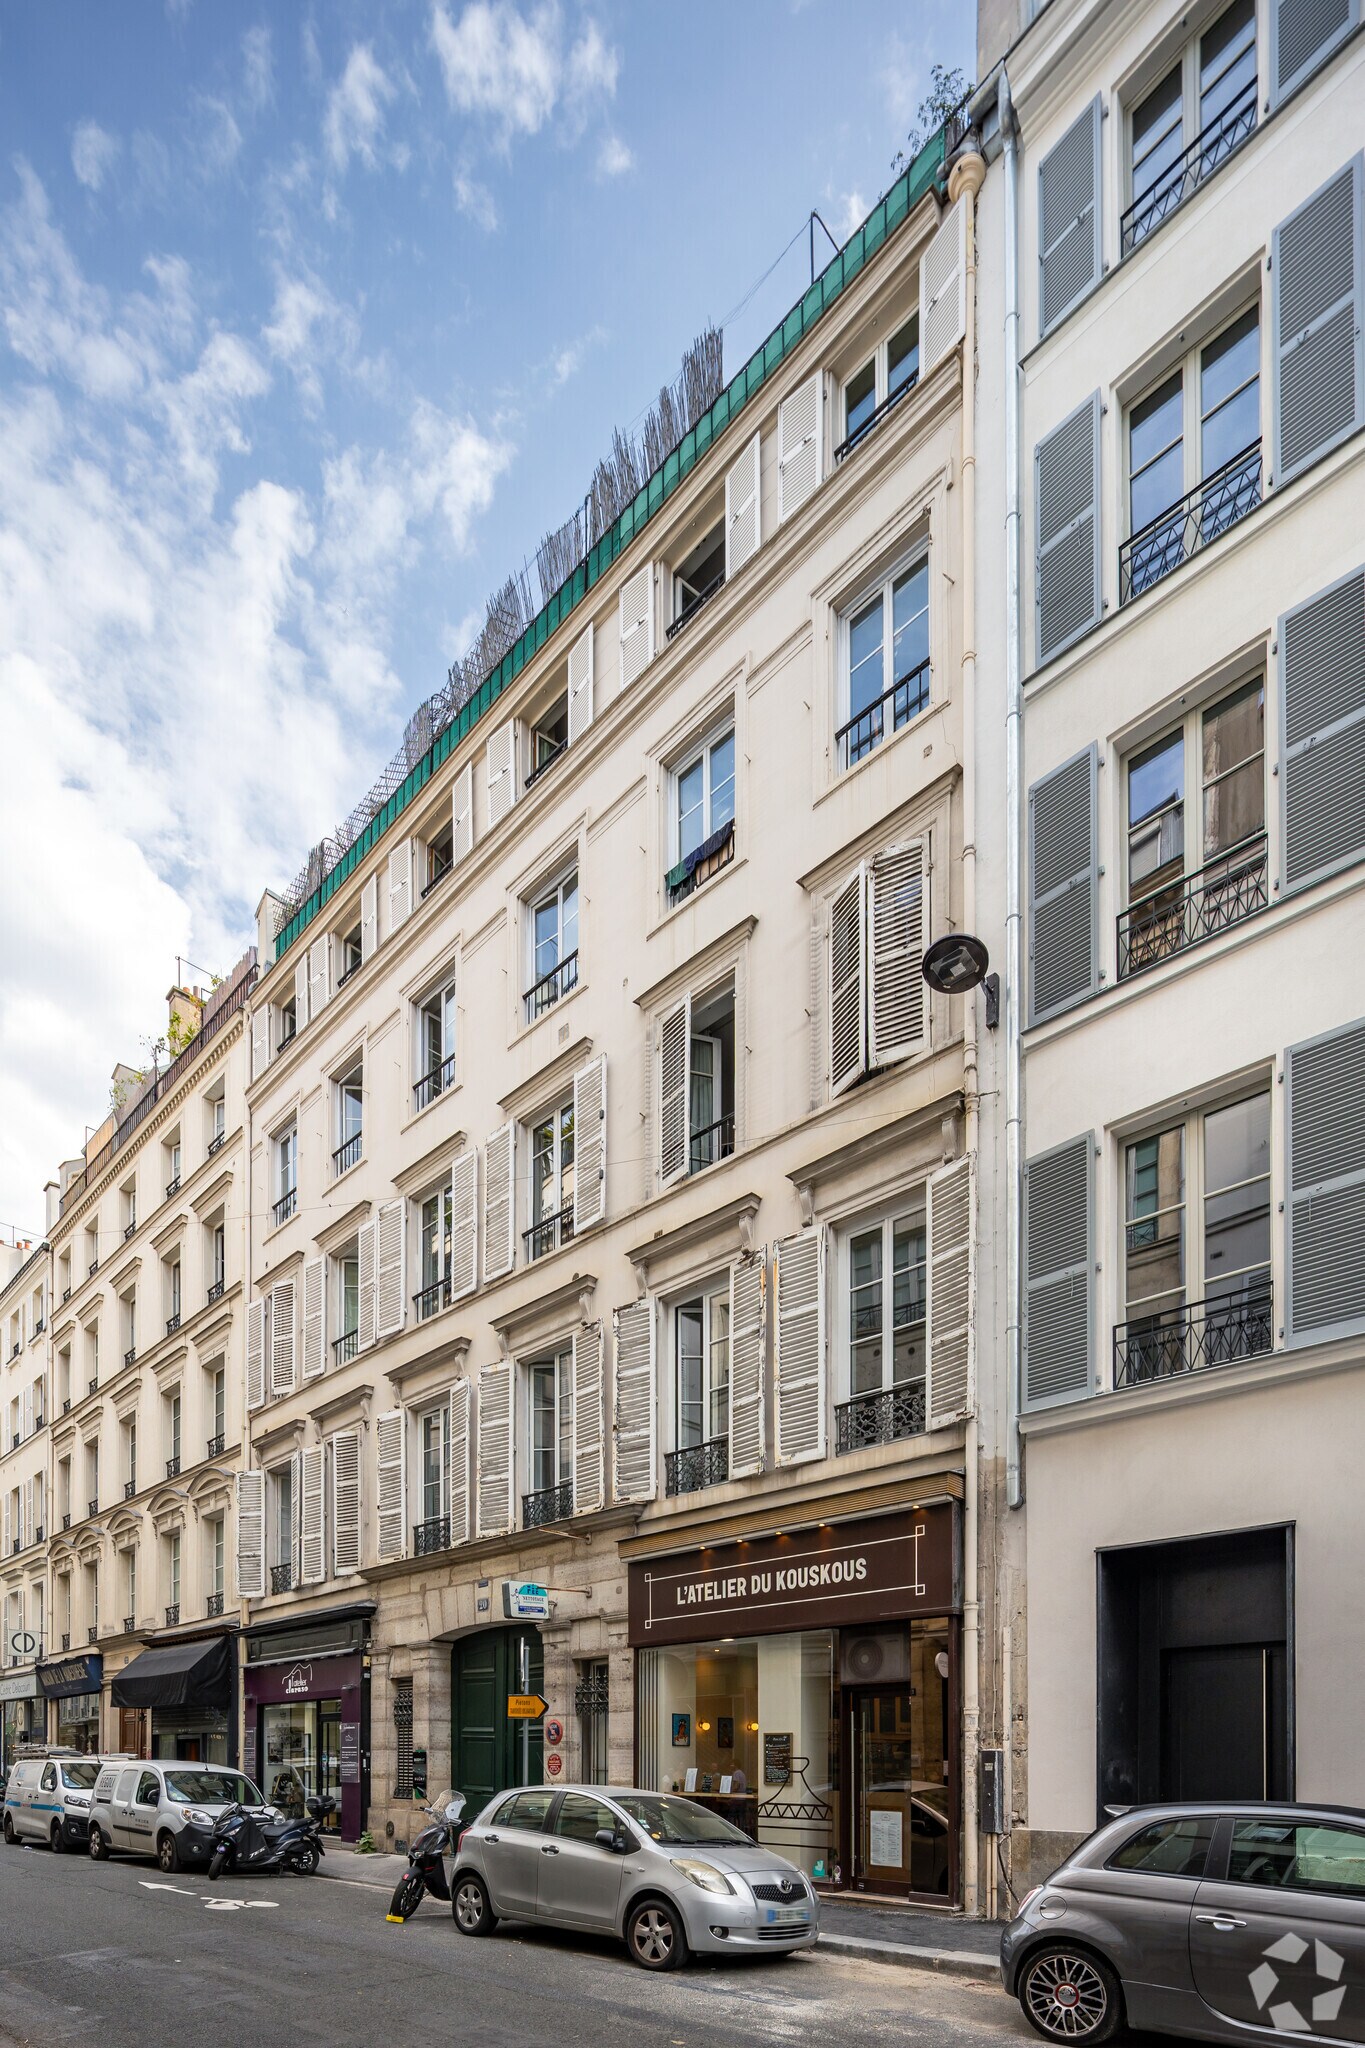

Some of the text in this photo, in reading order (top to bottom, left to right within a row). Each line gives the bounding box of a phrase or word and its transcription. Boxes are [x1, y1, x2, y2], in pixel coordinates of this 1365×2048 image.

[676, 1557, 867, 1605] L'ATELIER DU KOUSKOUS
[11, 1632, 36, 1653] CD
